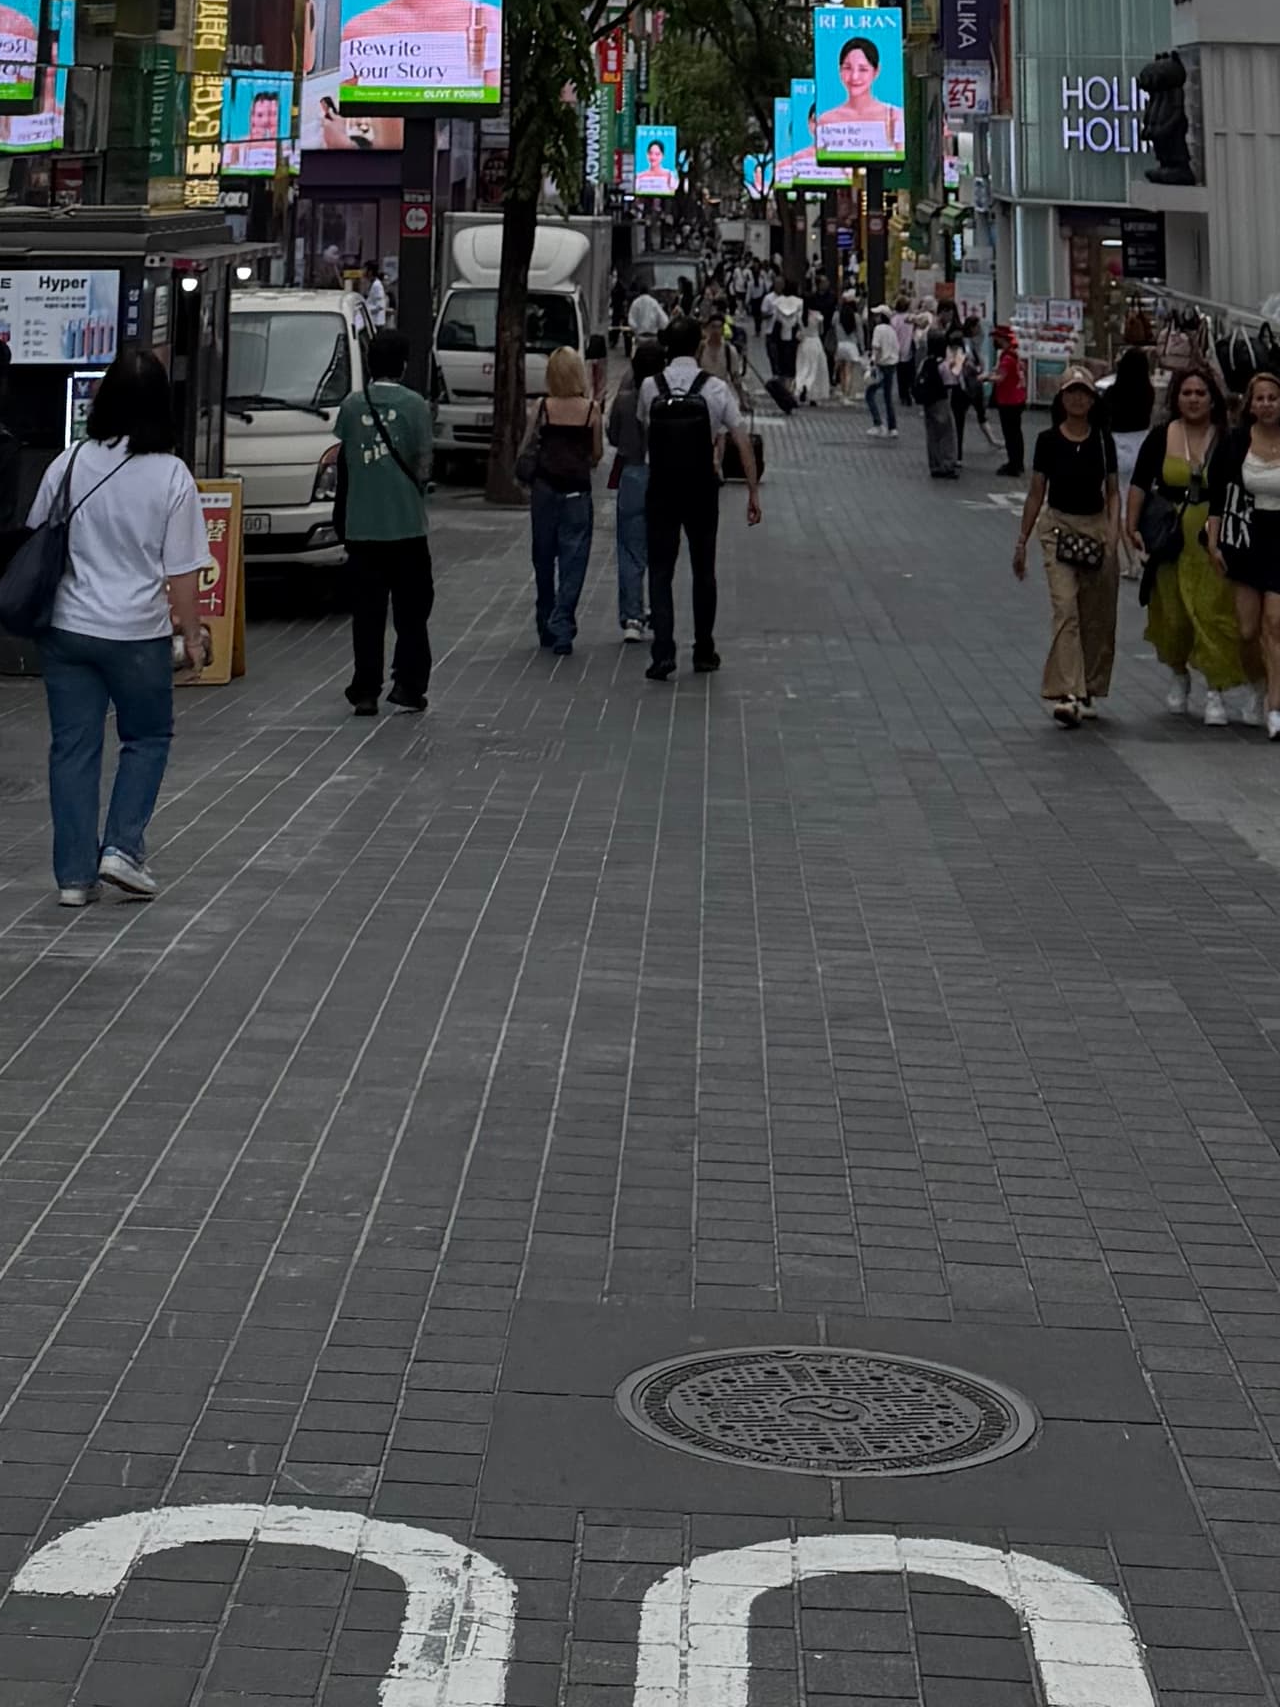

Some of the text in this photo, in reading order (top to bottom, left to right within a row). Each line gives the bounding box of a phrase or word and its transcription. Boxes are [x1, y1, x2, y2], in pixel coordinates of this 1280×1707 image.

[349, 39, 422, 57] Rewrite
[349, 61, 448, 84] Your Story
[948, 77, 977, 110] 药
[38, 275, 88, 292] Hyper
